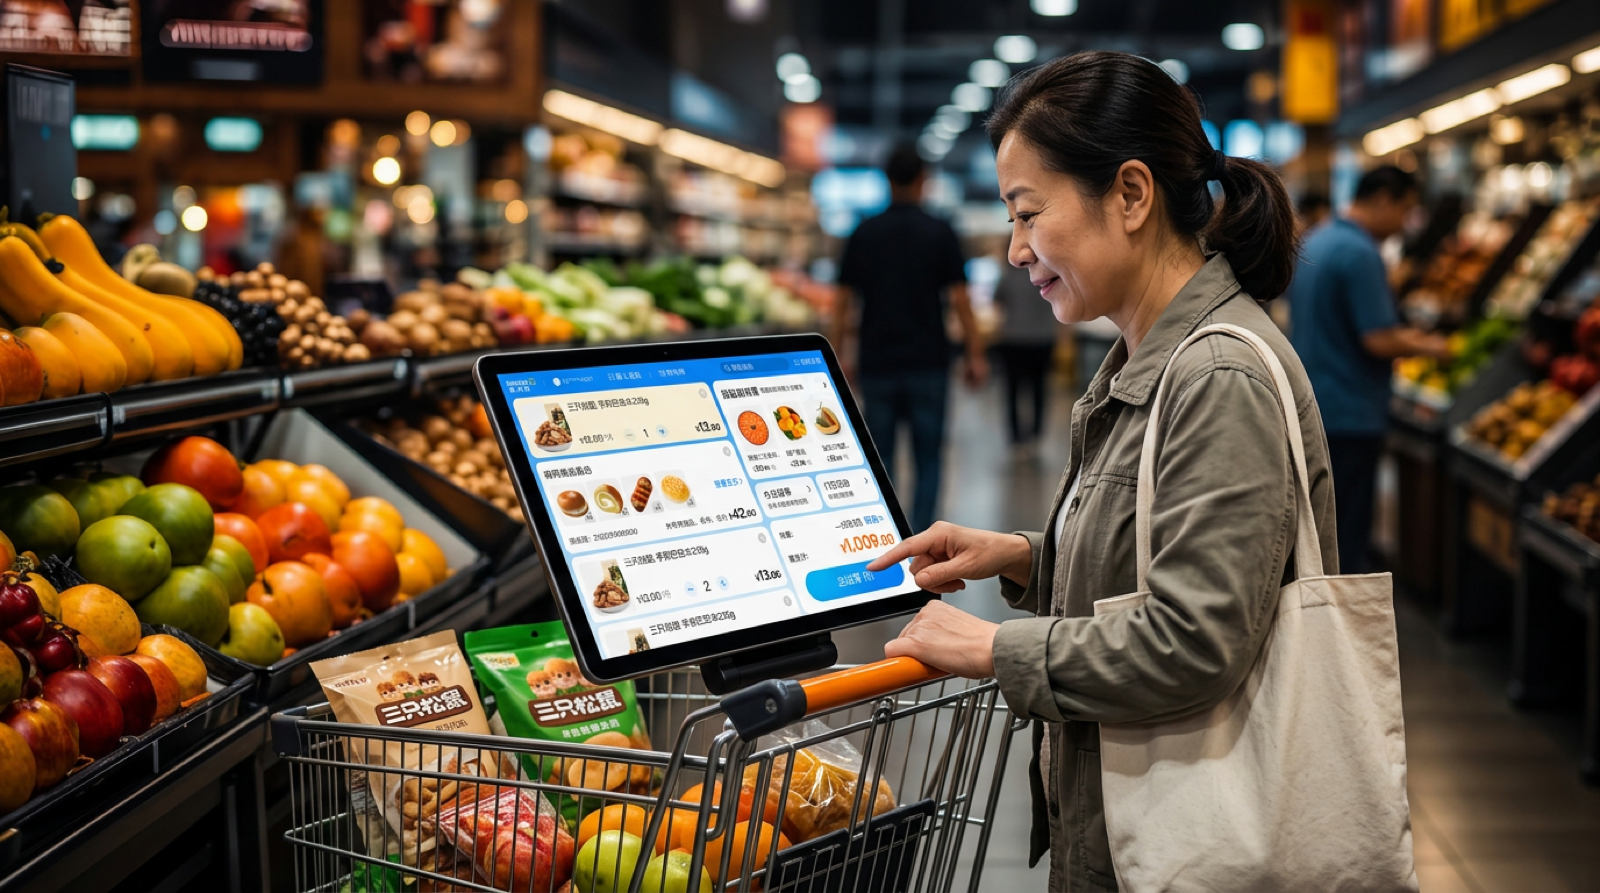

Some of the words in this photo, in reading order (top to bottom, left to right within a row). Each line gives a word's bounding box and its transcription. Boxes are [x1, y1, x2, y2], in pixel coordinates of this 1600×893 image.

[703, 580, 711, 592] 2
[380, 688, 468, 725] 三只松鼠
[533, 688, 622, 722] 三只松鼠
